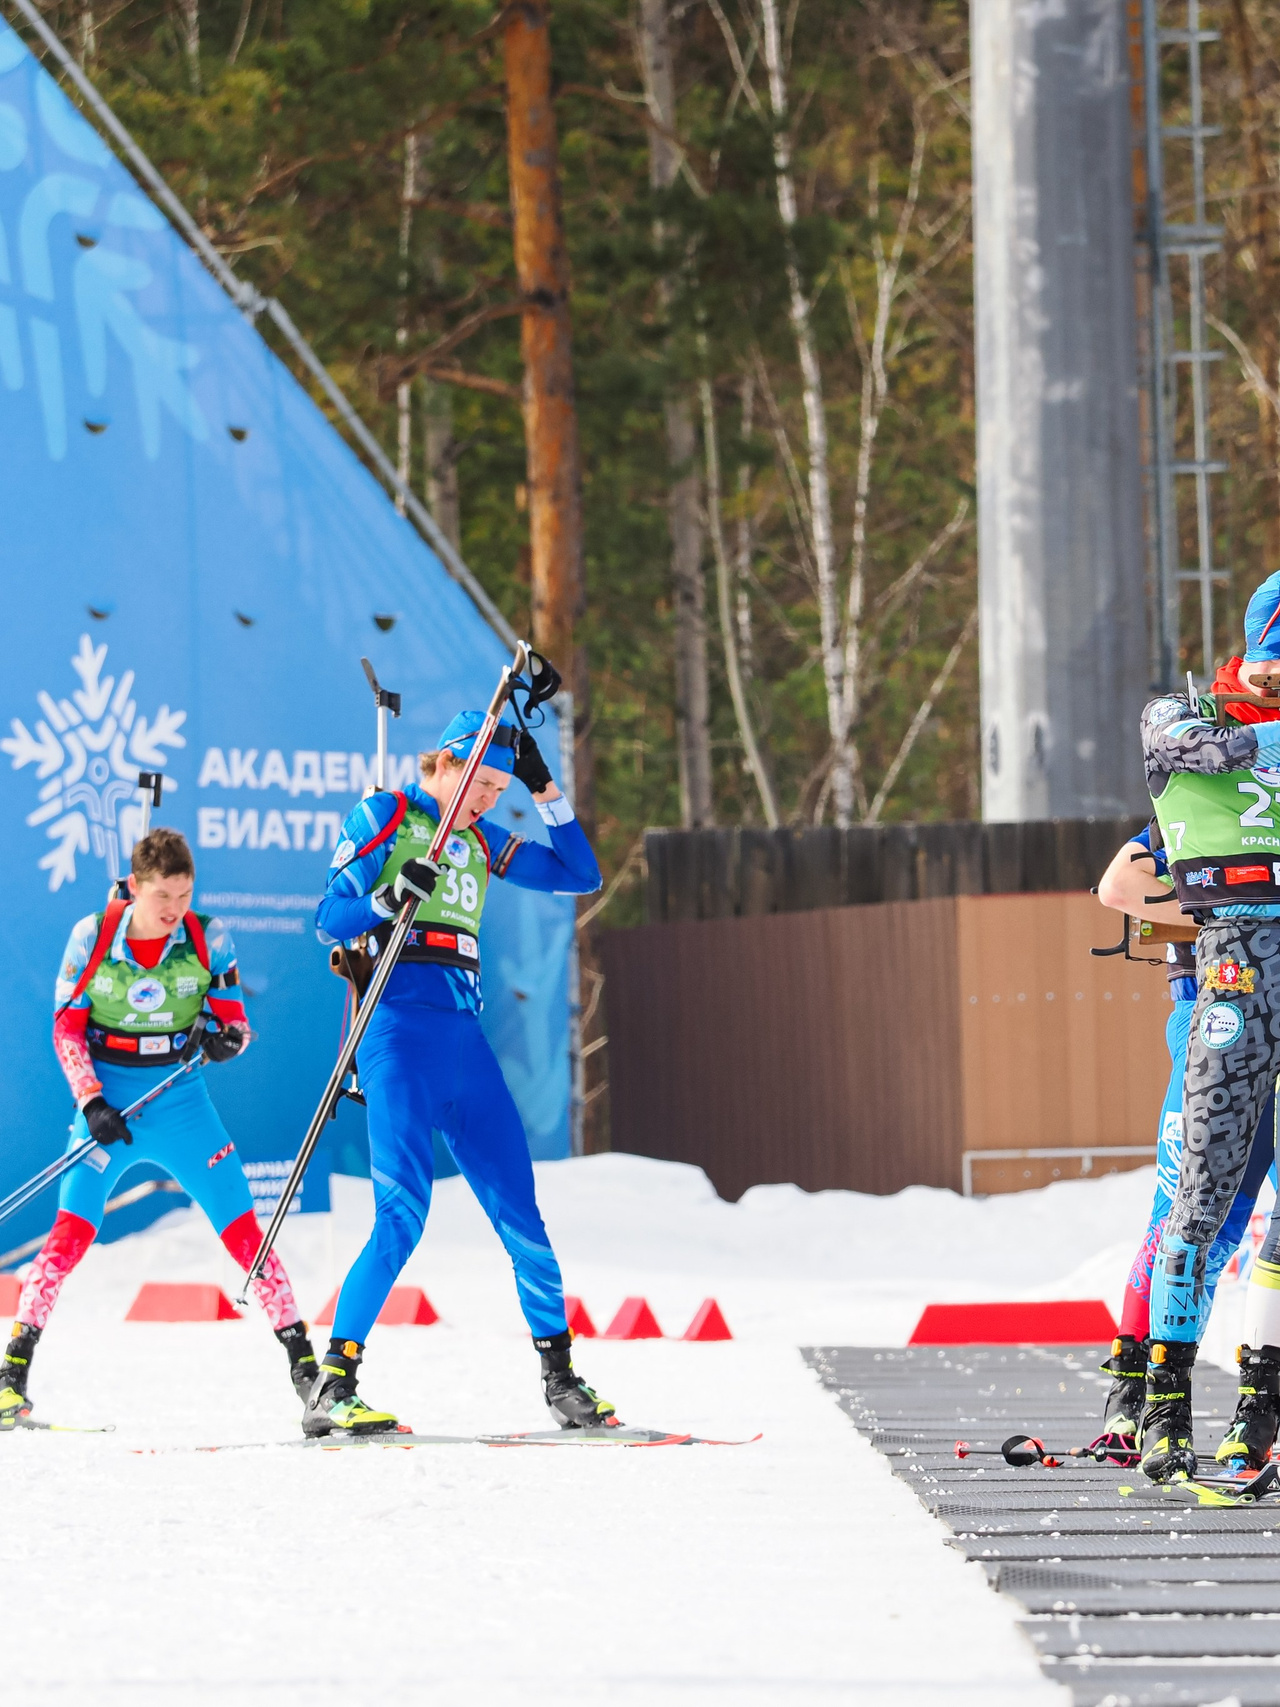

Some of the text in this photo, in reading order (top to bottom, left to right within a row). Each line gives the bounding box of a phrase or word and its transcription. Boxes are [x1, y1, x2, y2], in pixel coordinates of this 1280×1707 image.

[198, 747, 420, 799] АКАДЕМИ
[197, 807, 344, 851] БИАТЛ
[442, 868, 478, 912] 38
